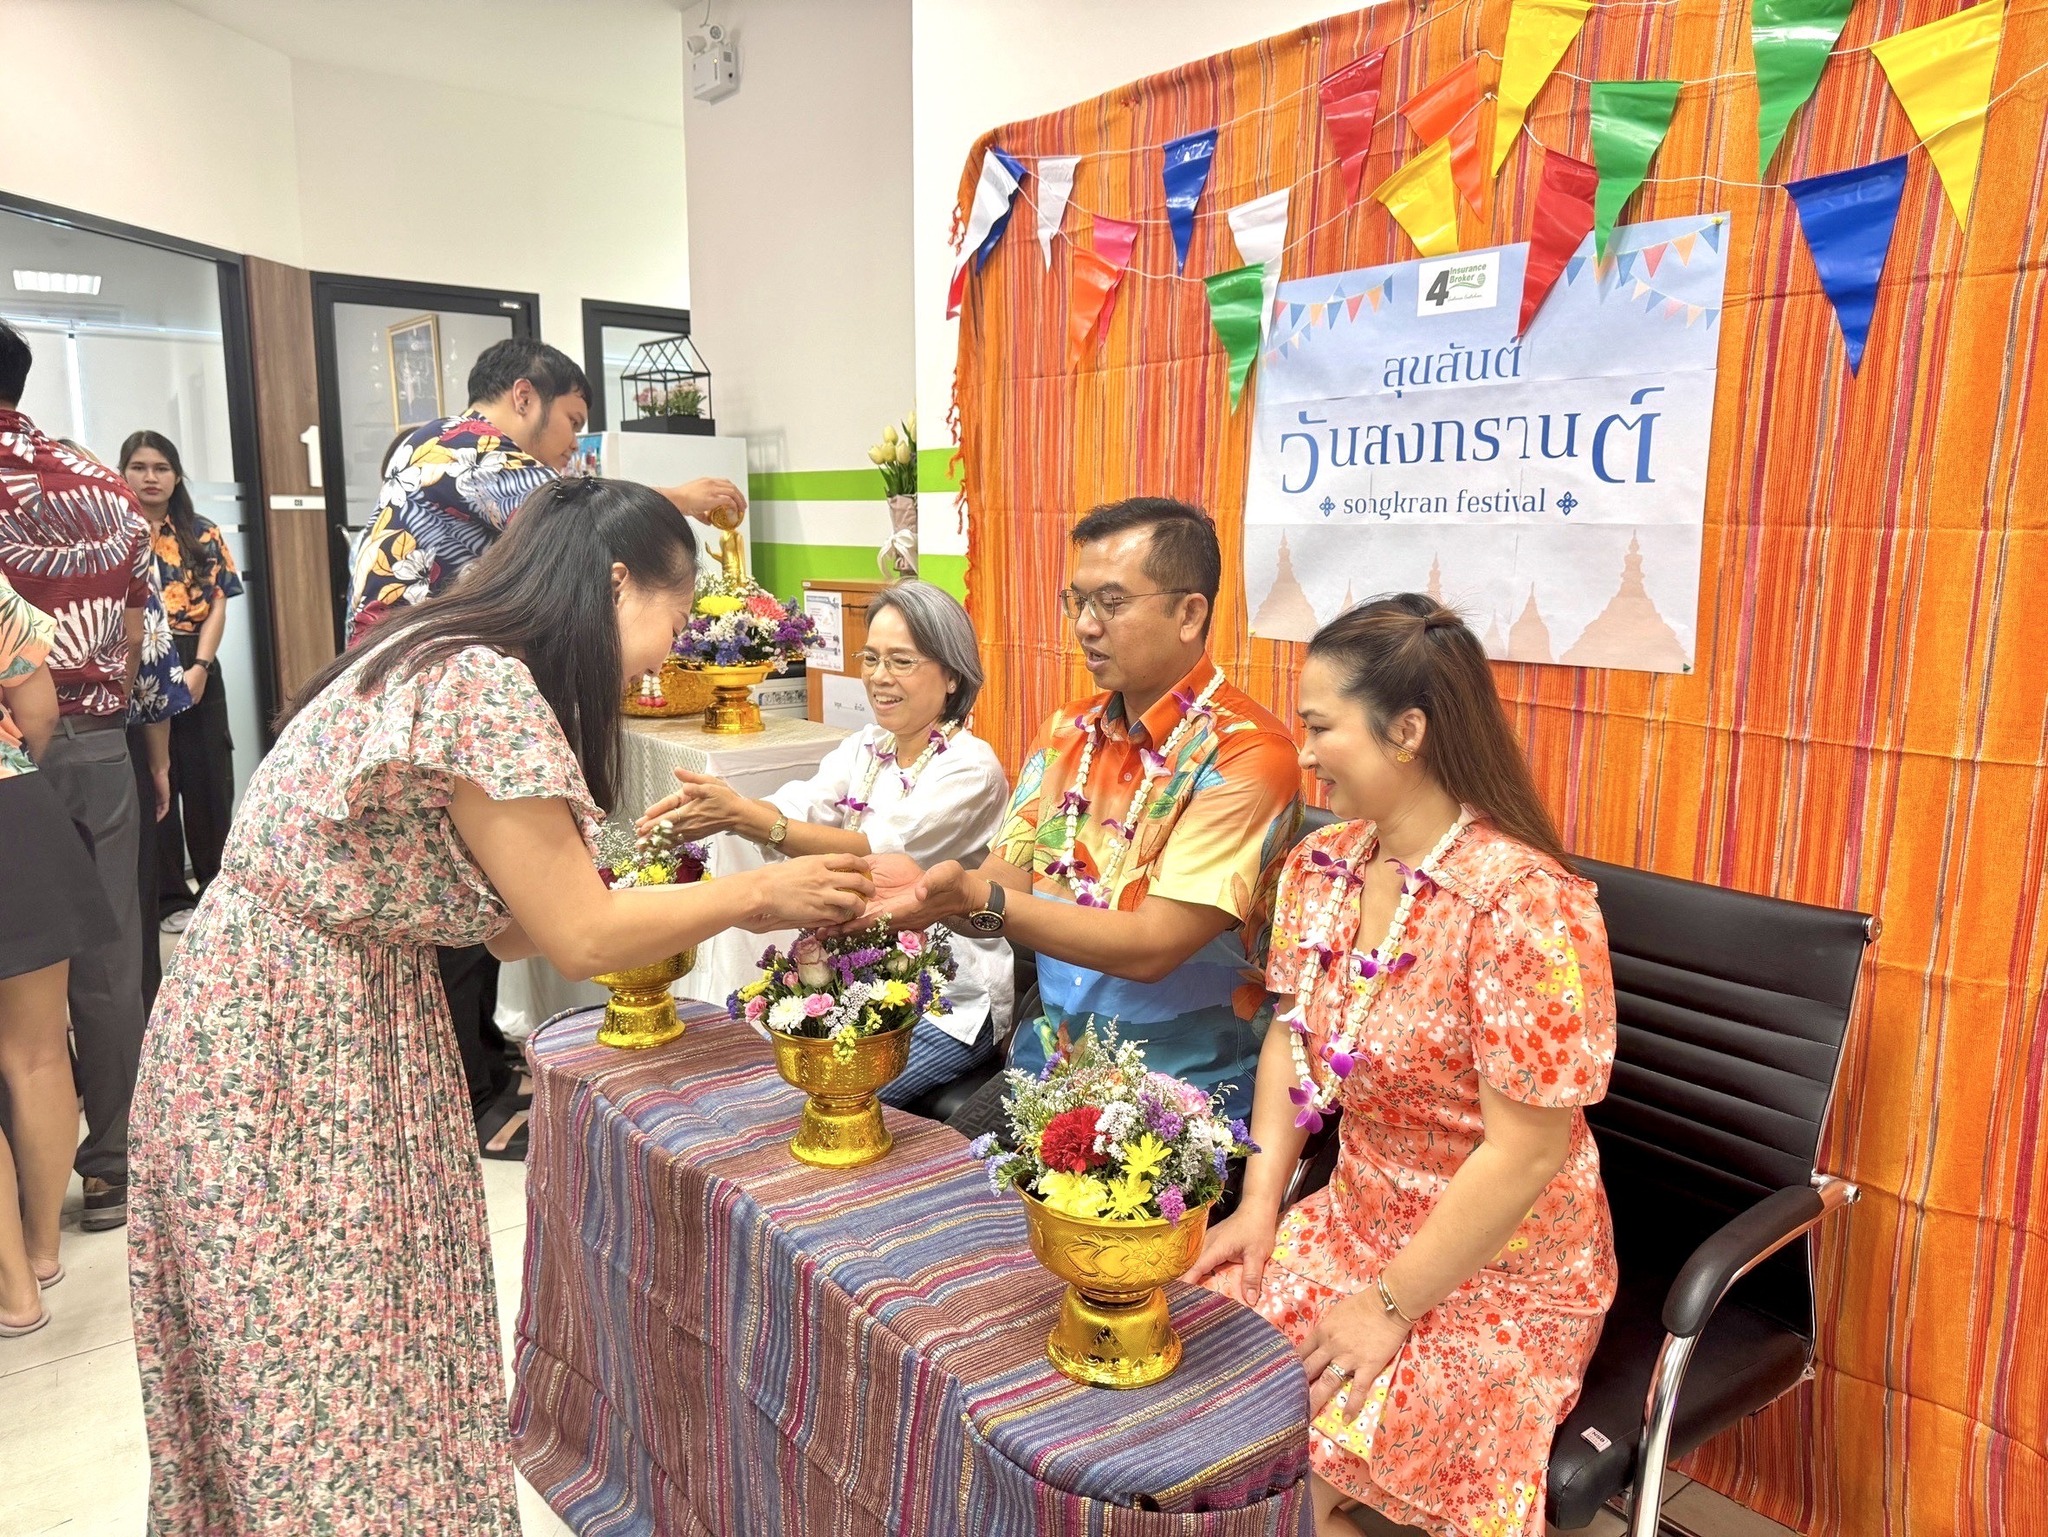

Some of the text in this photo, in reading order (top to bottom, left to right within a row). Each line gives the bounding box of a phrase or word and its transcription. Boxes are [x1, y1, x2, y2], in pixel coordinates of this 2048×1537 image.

[1425, 269, 1450, 306] 4
[1449, 263, 1487, 275] Insurance
[1449, 273, 1475, 284] Broker
[1383, 335, 1523, 399] สุขสันต์
[300, 425, 323, 488] 1
[1280, 386, 1665, 494] วันสงกรานต์
[1343, 488, 1547, 521] songkran festival
